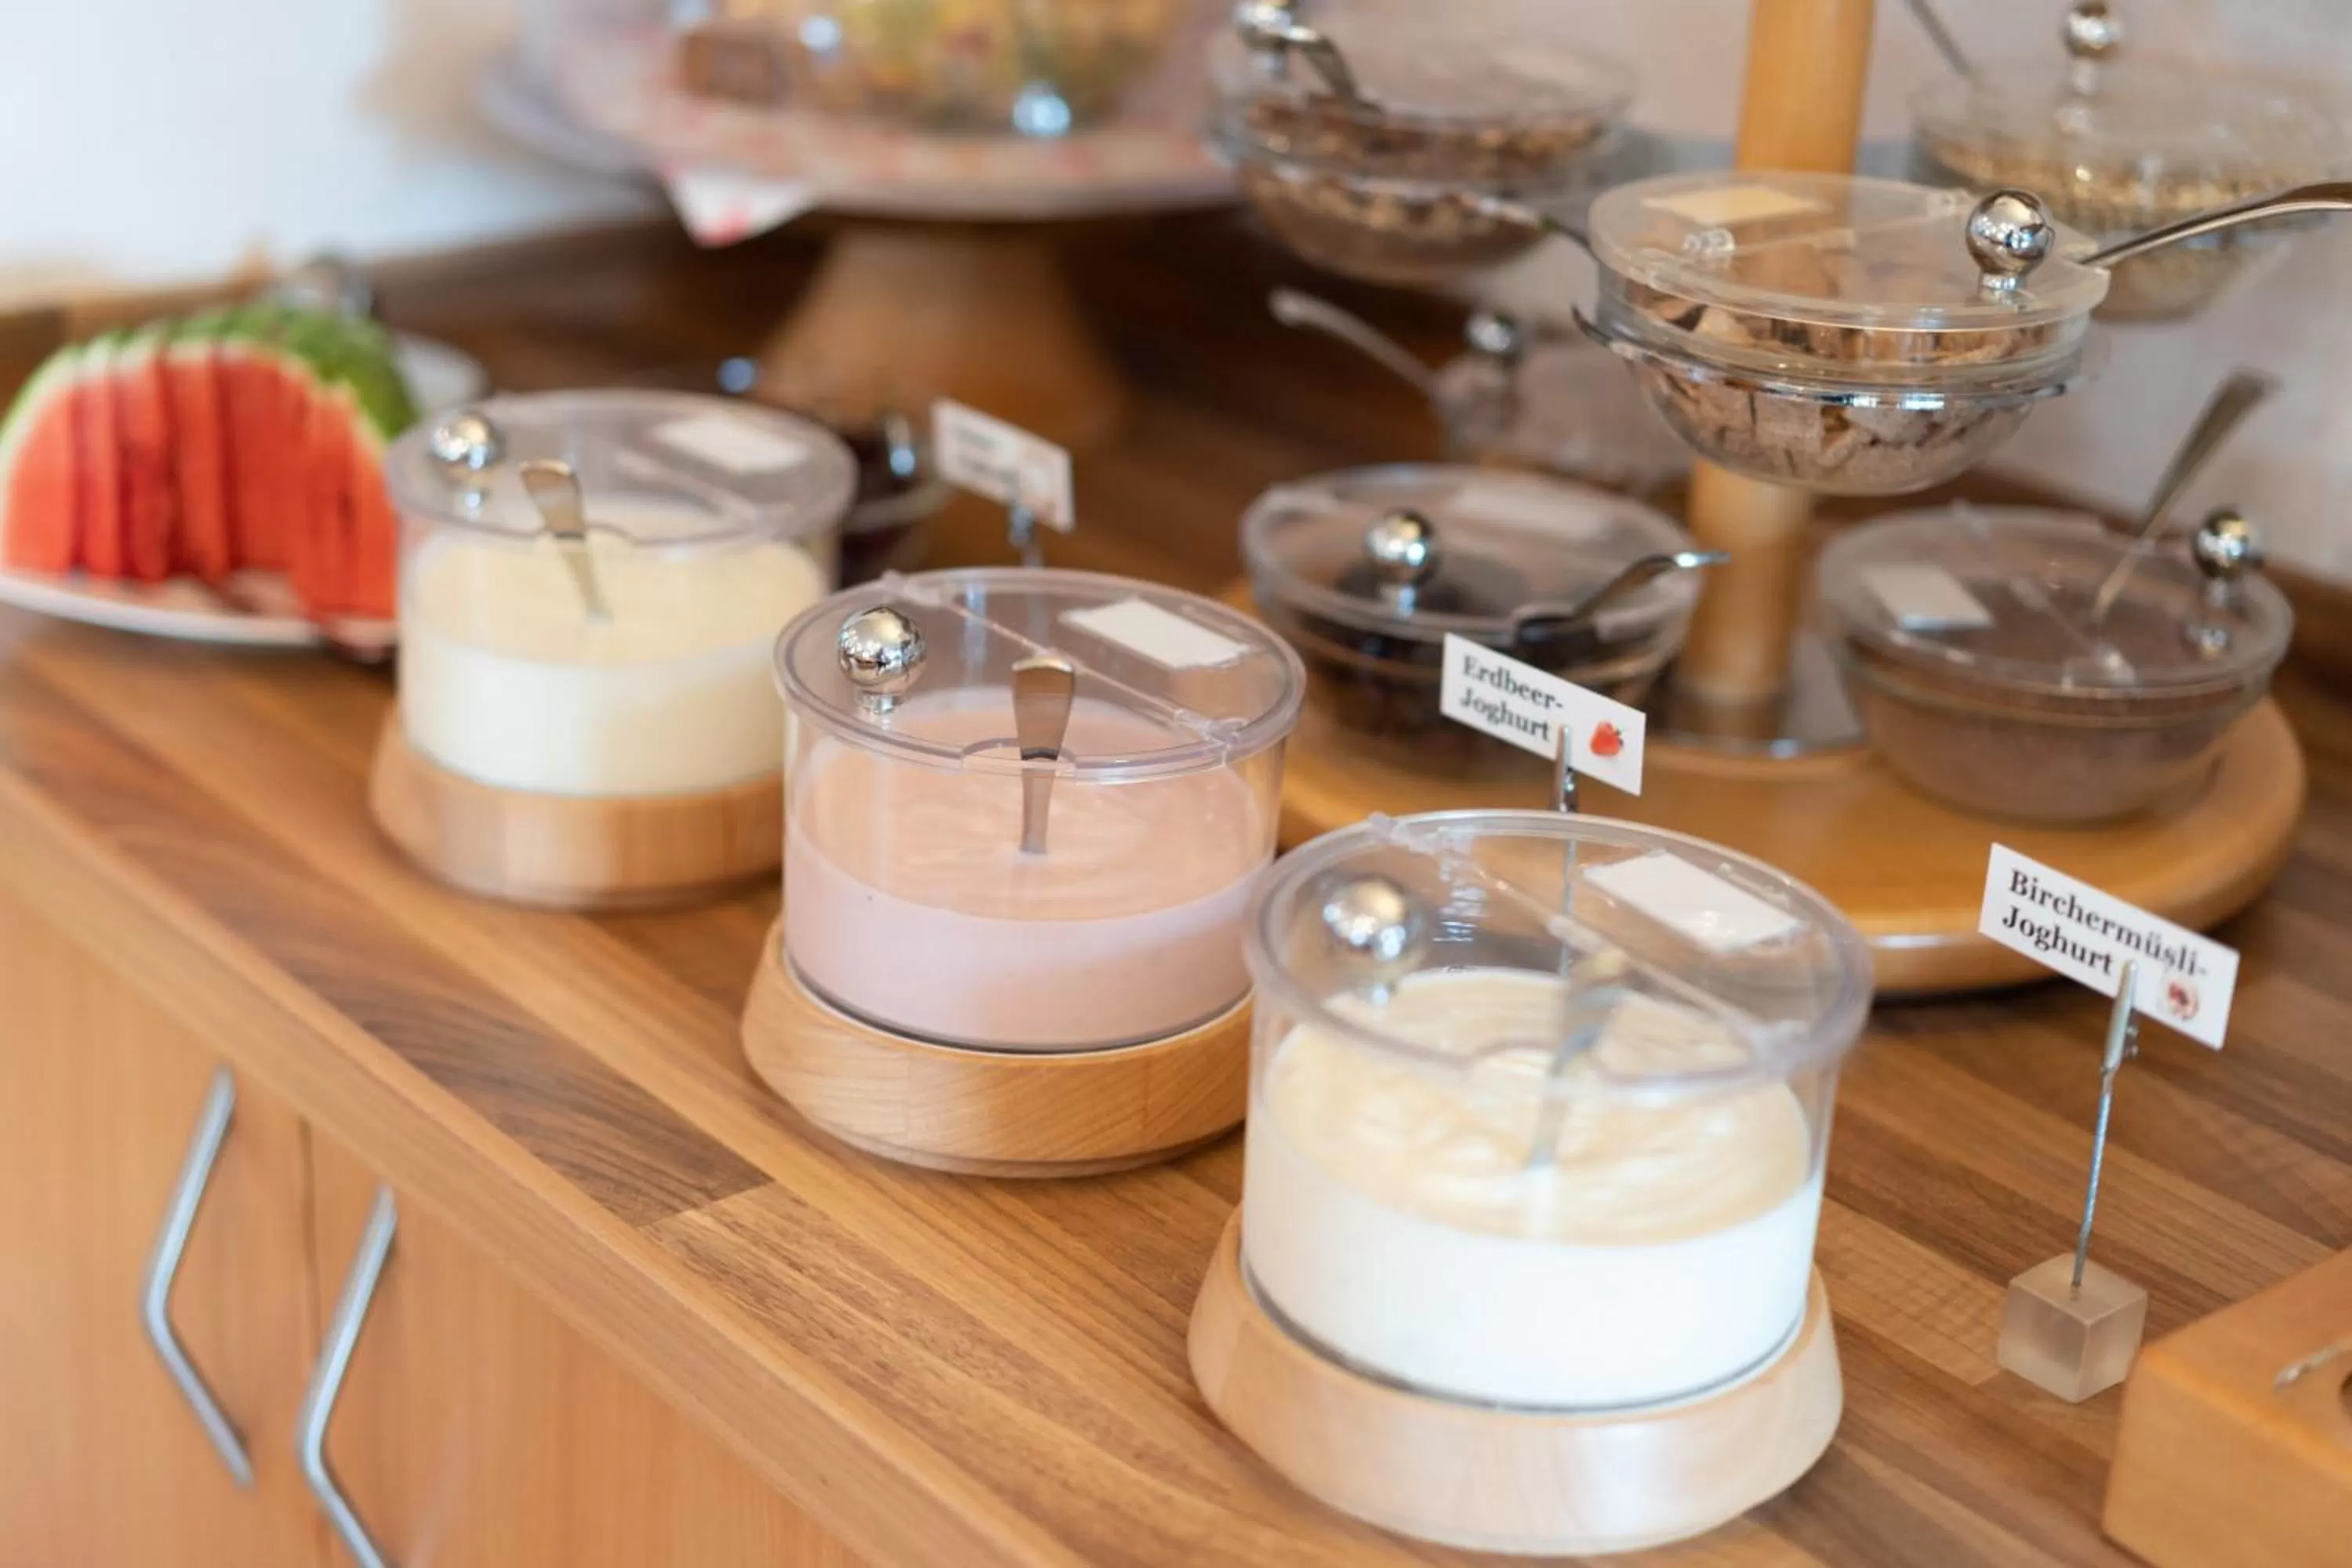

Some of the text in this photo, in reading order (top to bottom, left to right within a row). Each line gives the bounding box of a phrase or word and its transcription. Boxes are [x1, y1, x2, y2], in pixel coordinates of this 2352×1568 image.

[1462, 654, 1564, 710] Erdbeer-
[1460, 687, 1551, 742] Joghurt
[2001, 904, 2115, 977] Joghurt
[2009, 868, 2208, 976] Birchermüsli-
